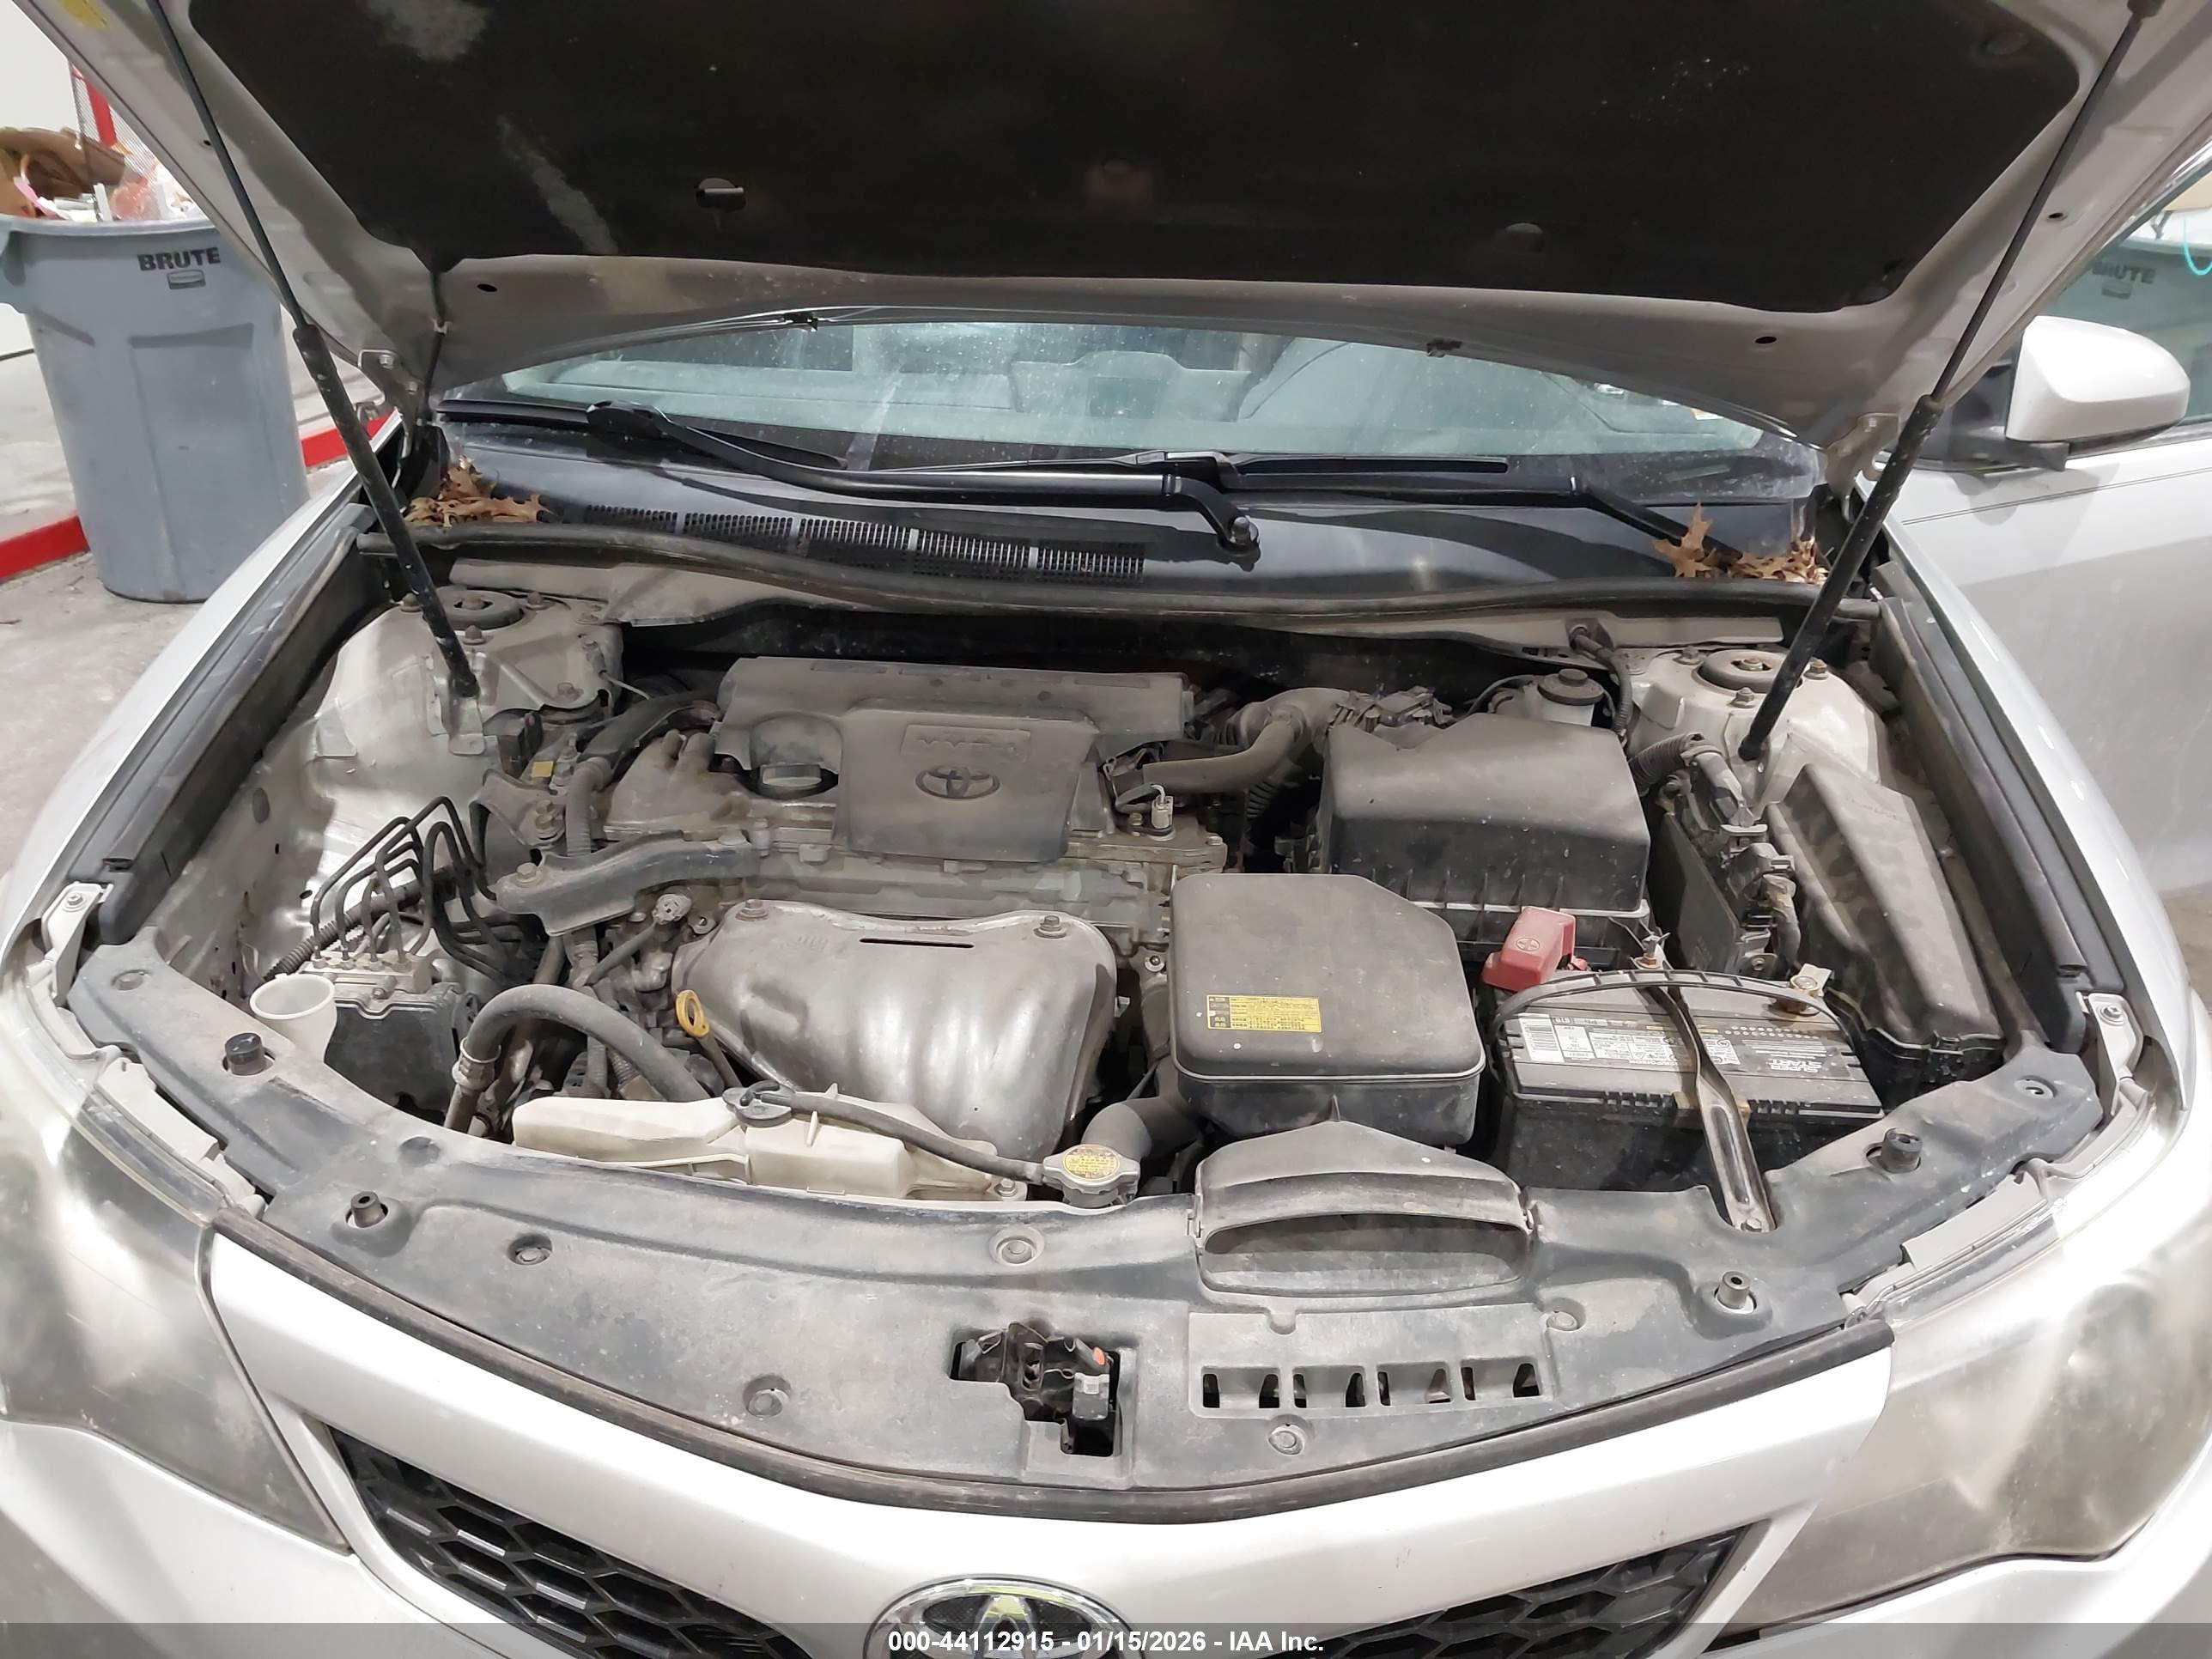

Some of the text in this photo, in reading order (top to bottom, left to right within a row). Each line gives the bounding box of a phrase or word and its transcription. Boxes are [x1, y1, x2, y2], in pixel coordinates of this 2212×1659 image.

[137, 247, 221, 271] BRUTE
[1770, 1065, 1819, 1073] SUPER
[1771, 1059, 1822, 1069] START
